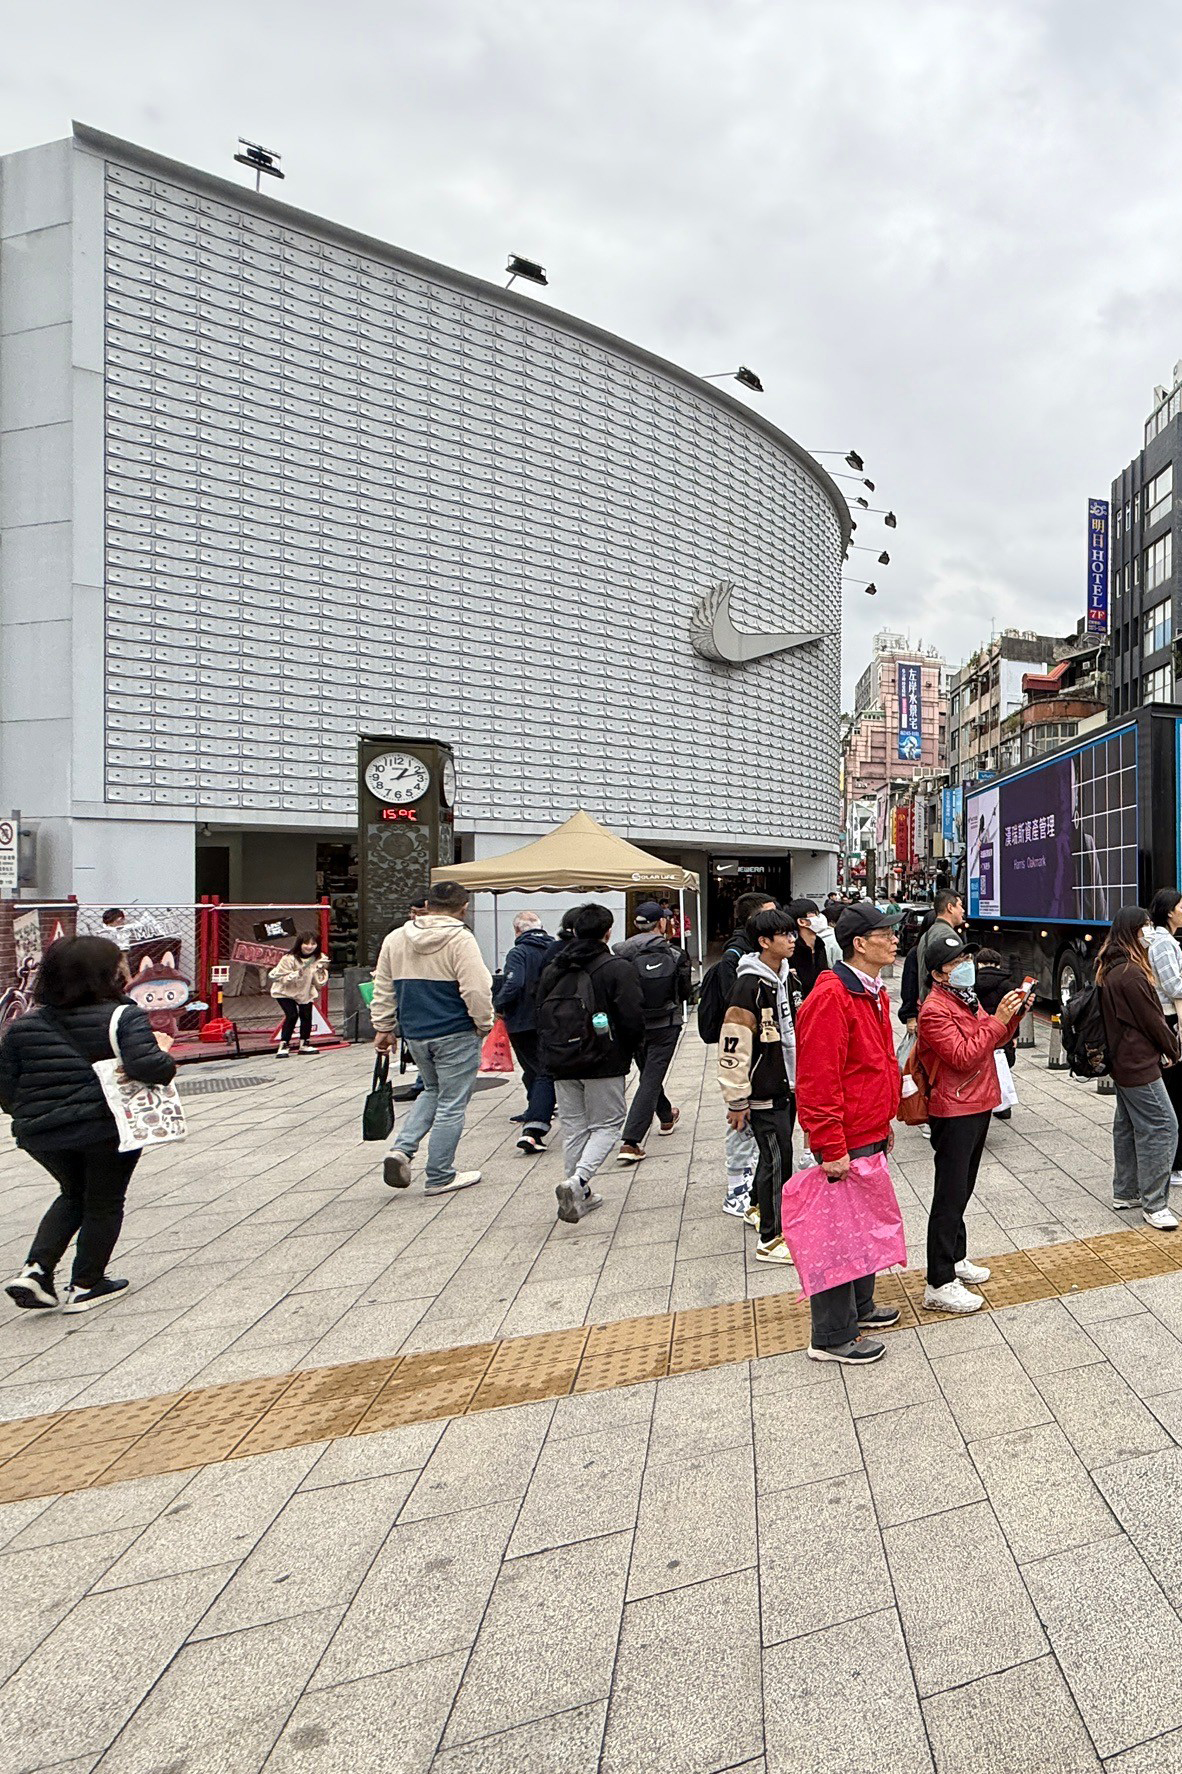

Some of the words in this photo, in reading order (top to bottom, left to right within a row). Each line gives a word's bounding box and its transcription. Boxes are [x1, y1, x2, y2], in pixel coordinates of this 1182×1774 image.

[1091, 517, 1105, 549] 明日
[1091, 550, 1105, 608] HOTEL
[1089, 610, 1105, 619] 7F
[908, 668, 918, 730] 左岸水景宅
[393, 757, 405, 765] 12
[374, 764, 386, 773] 10
[372, 774, 380, 782] 9
[416, 774, 425, 783] 3
[375, 781, 384, 790] 8
[413, 783, 422, 791] 4
[384, 788, 392, 797] 7
[394, 790, 402, 799] 6
[405, 788, 413, 797] 5
[631, 872, 660, 881] SOLAR
[723, 1036, 739, 1053] 17
